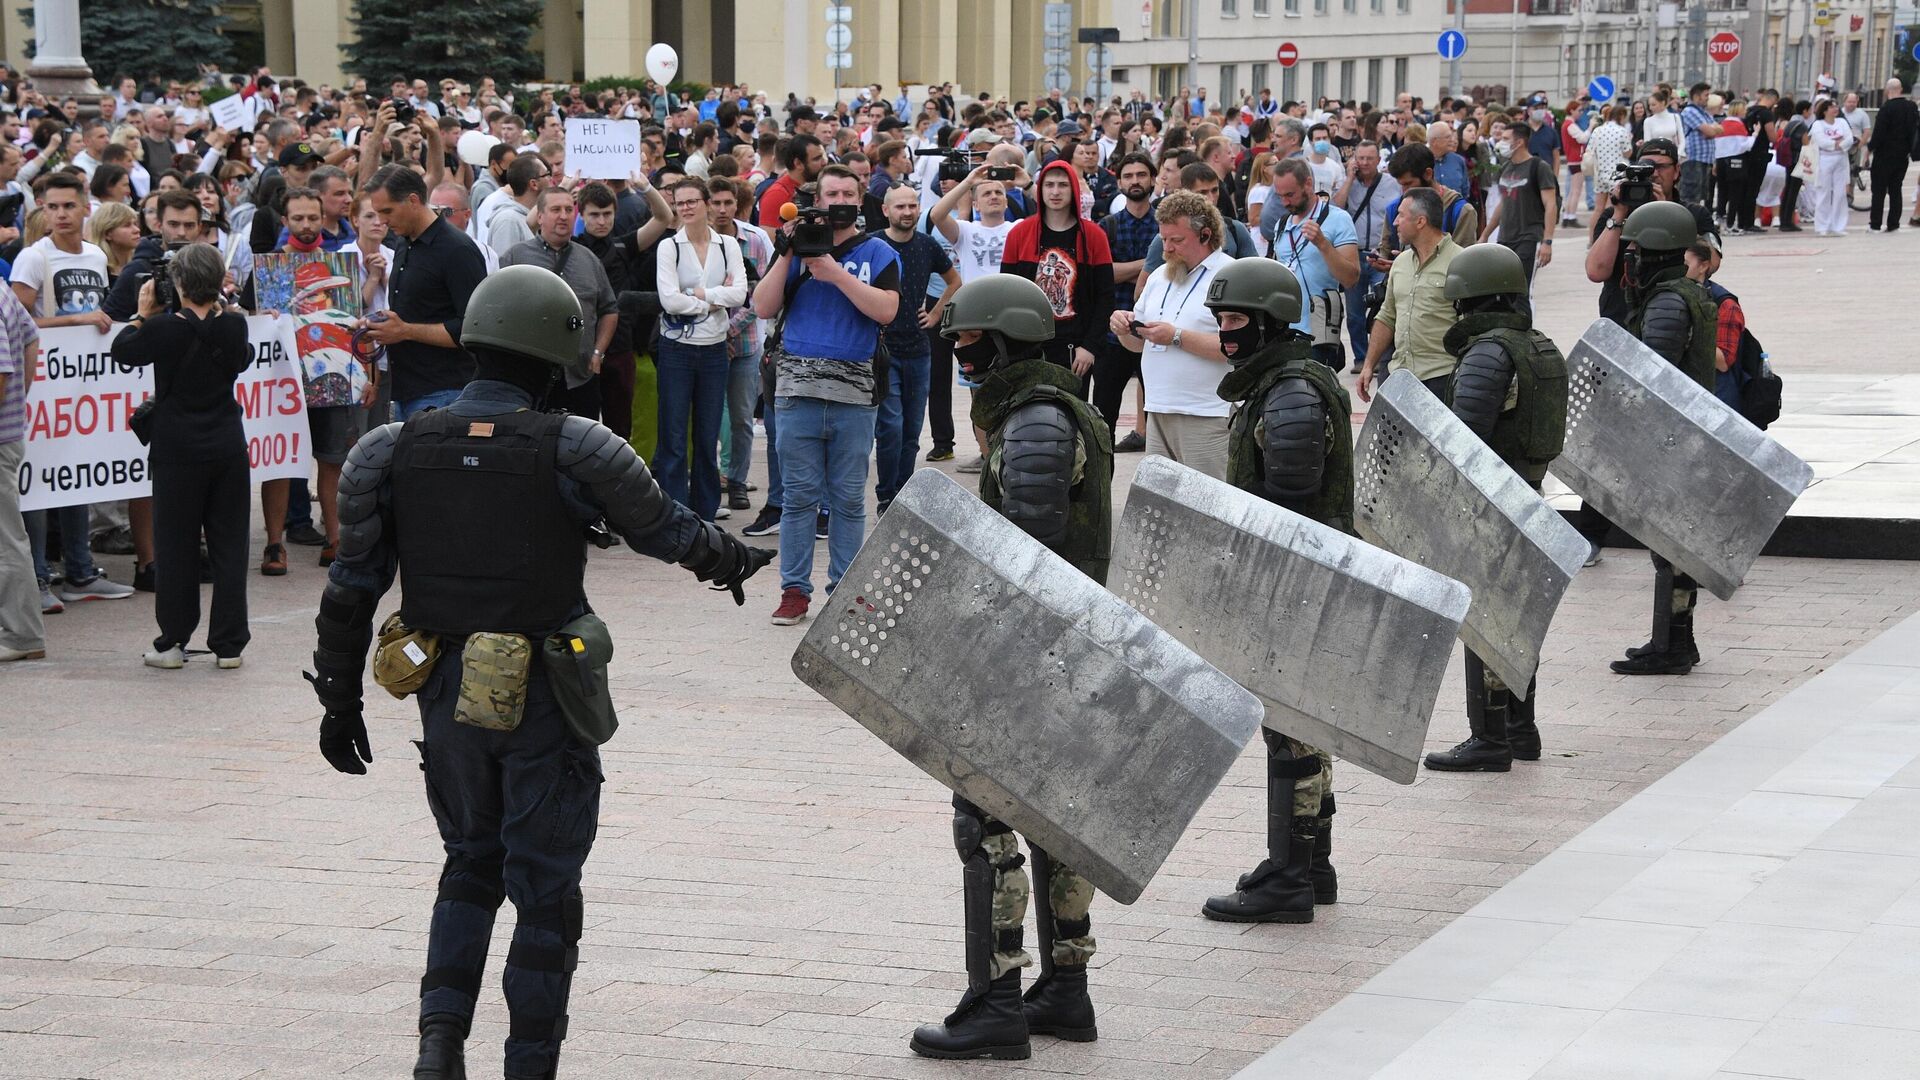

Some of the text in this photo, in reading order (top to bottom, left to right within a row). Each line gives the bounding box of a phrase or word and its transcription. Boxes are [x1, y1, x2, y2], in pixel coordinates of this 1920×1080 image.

[1710, 42, 1738, 53] STOP
[583, 124, 608, 135] НЕТ
[573, 144, 635, 154] НАСИЛИЮ
[972, 232, 1006, 248] SA
[236, 377, 302, 419] МТЗ
[42, 458, 153, 492] челове
[248, 432, 299, 469] 000!
[463, 455, 479, 466] КБ
